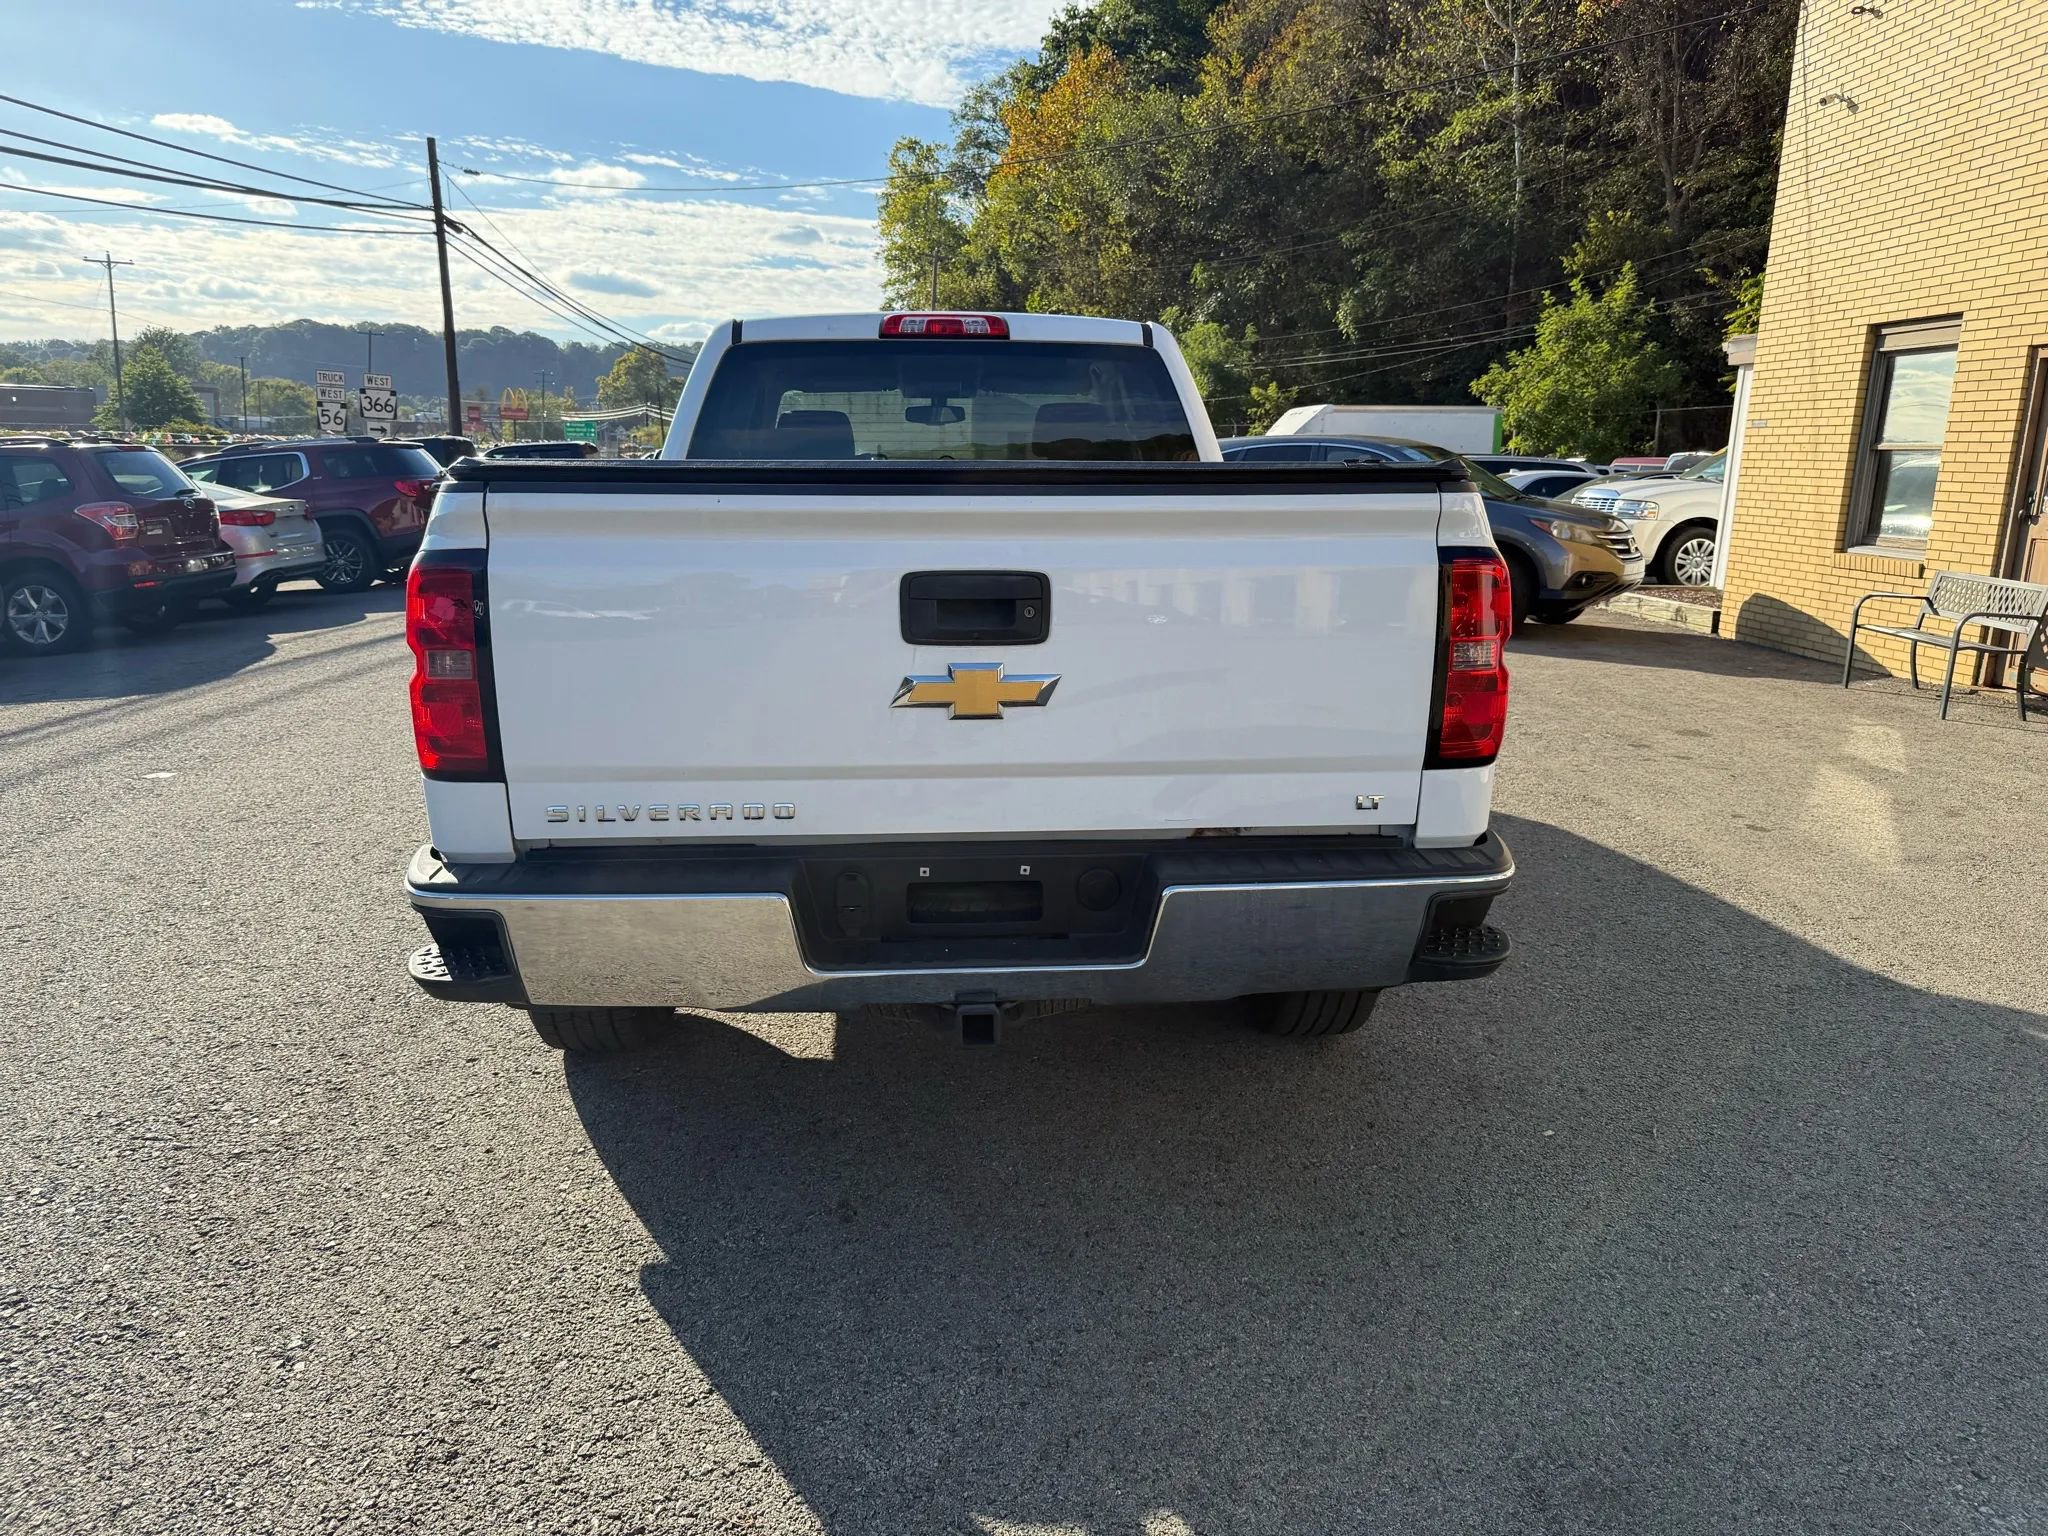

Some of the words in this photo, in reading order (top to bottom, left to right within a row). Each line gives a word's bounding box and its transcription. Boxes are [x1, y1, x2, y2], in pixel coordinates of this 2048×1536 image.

[318, 372, 344, 383] TRUCK
[366, 375, 389, 386] WEST
[320, 388, 342, 399] WEST
[363, 396, 394, 413] 366
[321, 409, 344, 426] 56
[1356, 794, 1385, 811] LT
[546, 802, 796, 823] SILVERADO
